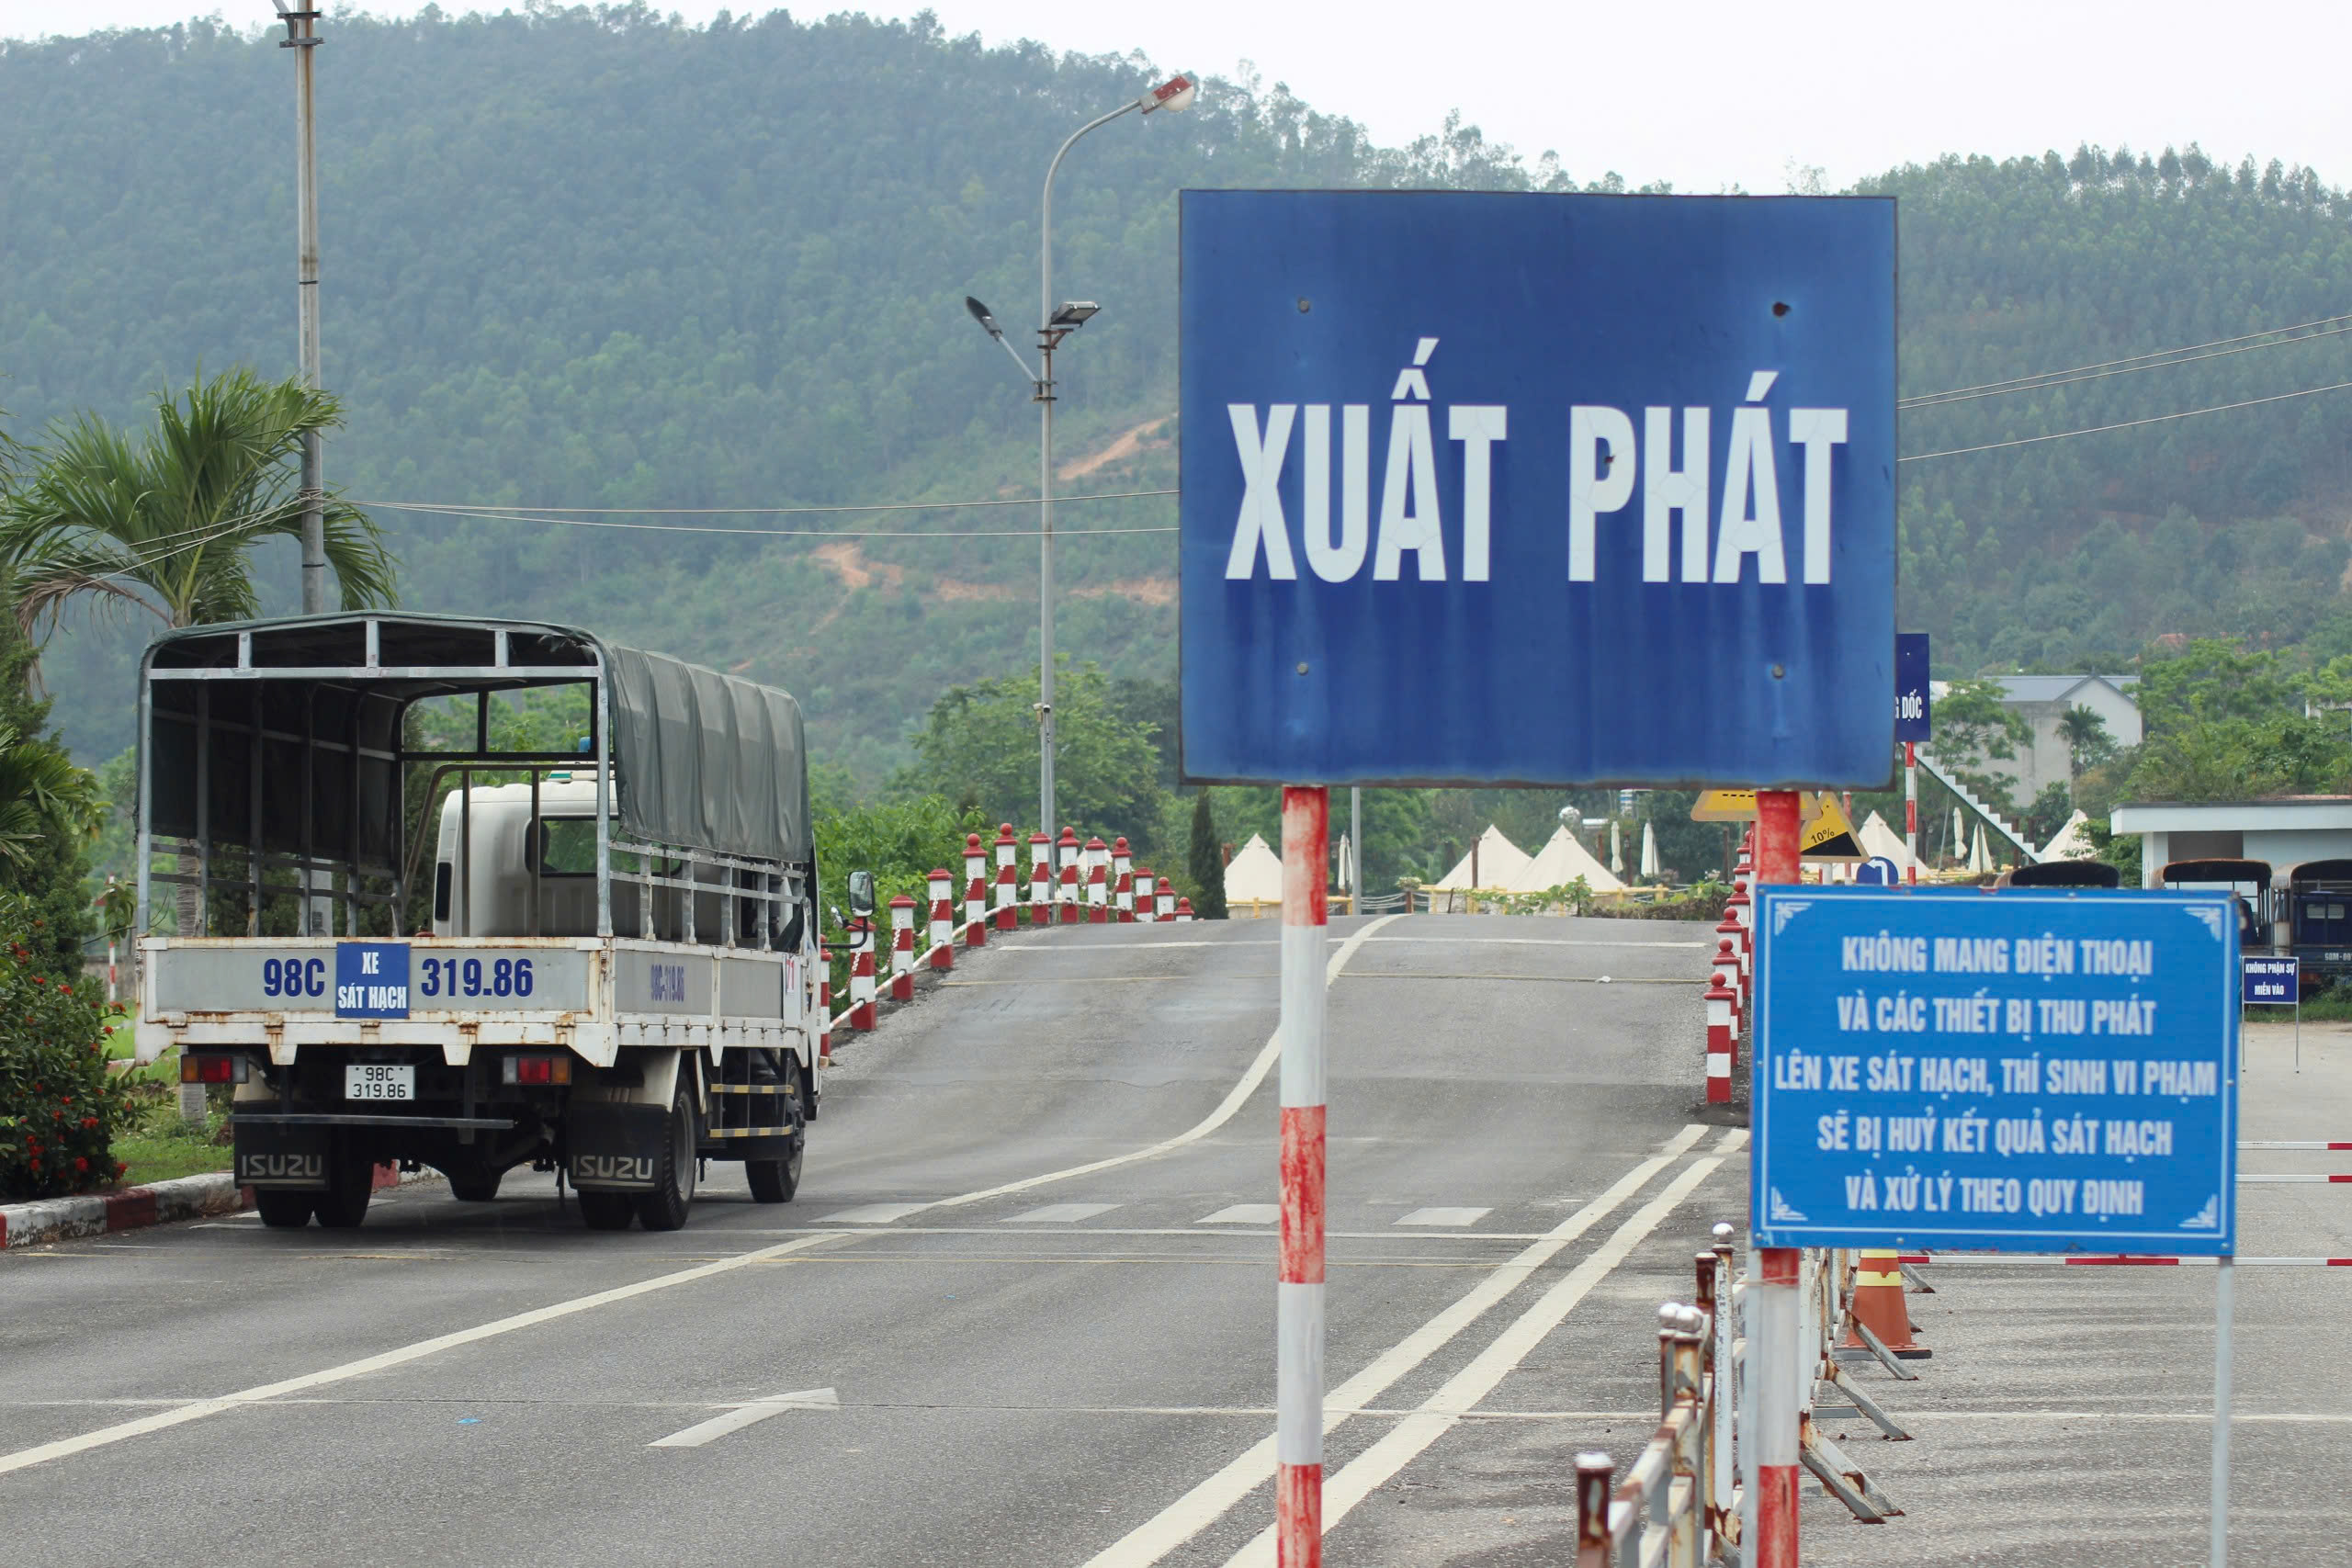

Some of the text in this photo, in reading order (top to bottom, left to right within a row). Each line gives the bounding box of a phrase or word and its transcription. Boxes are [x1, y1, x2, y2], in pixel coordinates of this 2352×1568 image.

[1226, 337, 1849, 584] XUẤT PHÁT
[1901, 688, 1923, 719] DỐC
[1810, 827, 1836, 844] 10%
[361, 952, 379, 975] XE
[1842, 930, 2153, 983] KHÔNG MANG ĐIỆN THOẠI
[2245, 961, 2296, 976] KHÔNG PHẬN SỰ
[264, 958, 533, 998] 98C 319.86
[2271, 983, 2285, 996] VÀO
[338, 983, 407, 1011] SÁT HẠCH
[1838, 987, 2156, 1041] VÀ CÁC THIẾT BỊ THU PHÁT
[365, 1066, 395, 1081] 98C
[1775, 1048, 2217, 1103] LÊN XE SÁT HẠCH, THÍ SINH VI PHẠM
[353, 1083, 406, 1100] 319.86
[1817, 1106, 2172, 1162] SẼ BỊ HUỶ KẾT QUẢ SÁT HẠCH
[242, 1154, 322, 1178] ISUZU
[571, 1155, 654, 1179] ISUZU
[1846, 1165, 2143, 1222] VÀ XỬ LÝ THEO QUY ĐỊNH
